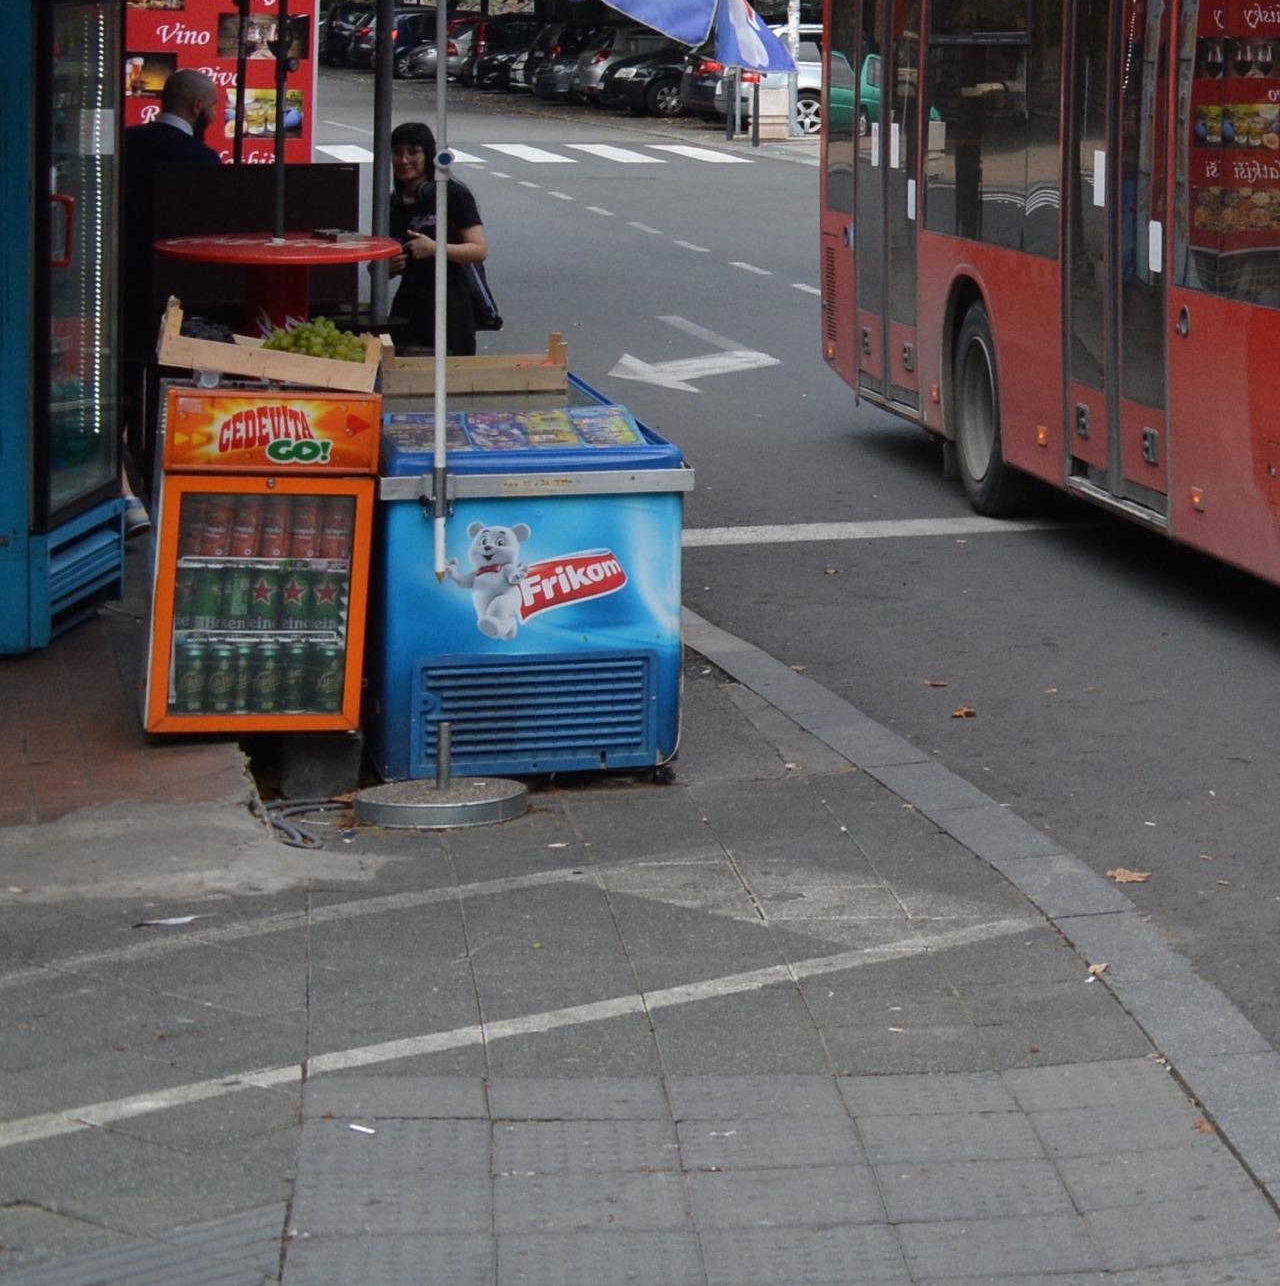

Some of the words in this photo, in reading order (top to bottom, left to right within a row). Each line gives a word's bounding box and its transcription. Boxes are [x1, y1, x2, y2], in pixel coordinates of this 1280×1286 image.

[156, 23, 210, 45] Vino
[218, 405, 314, 453] CEDEVITA
[267, 440, 331, 462] GO!
[521, 558, 622, 607] Frikom
